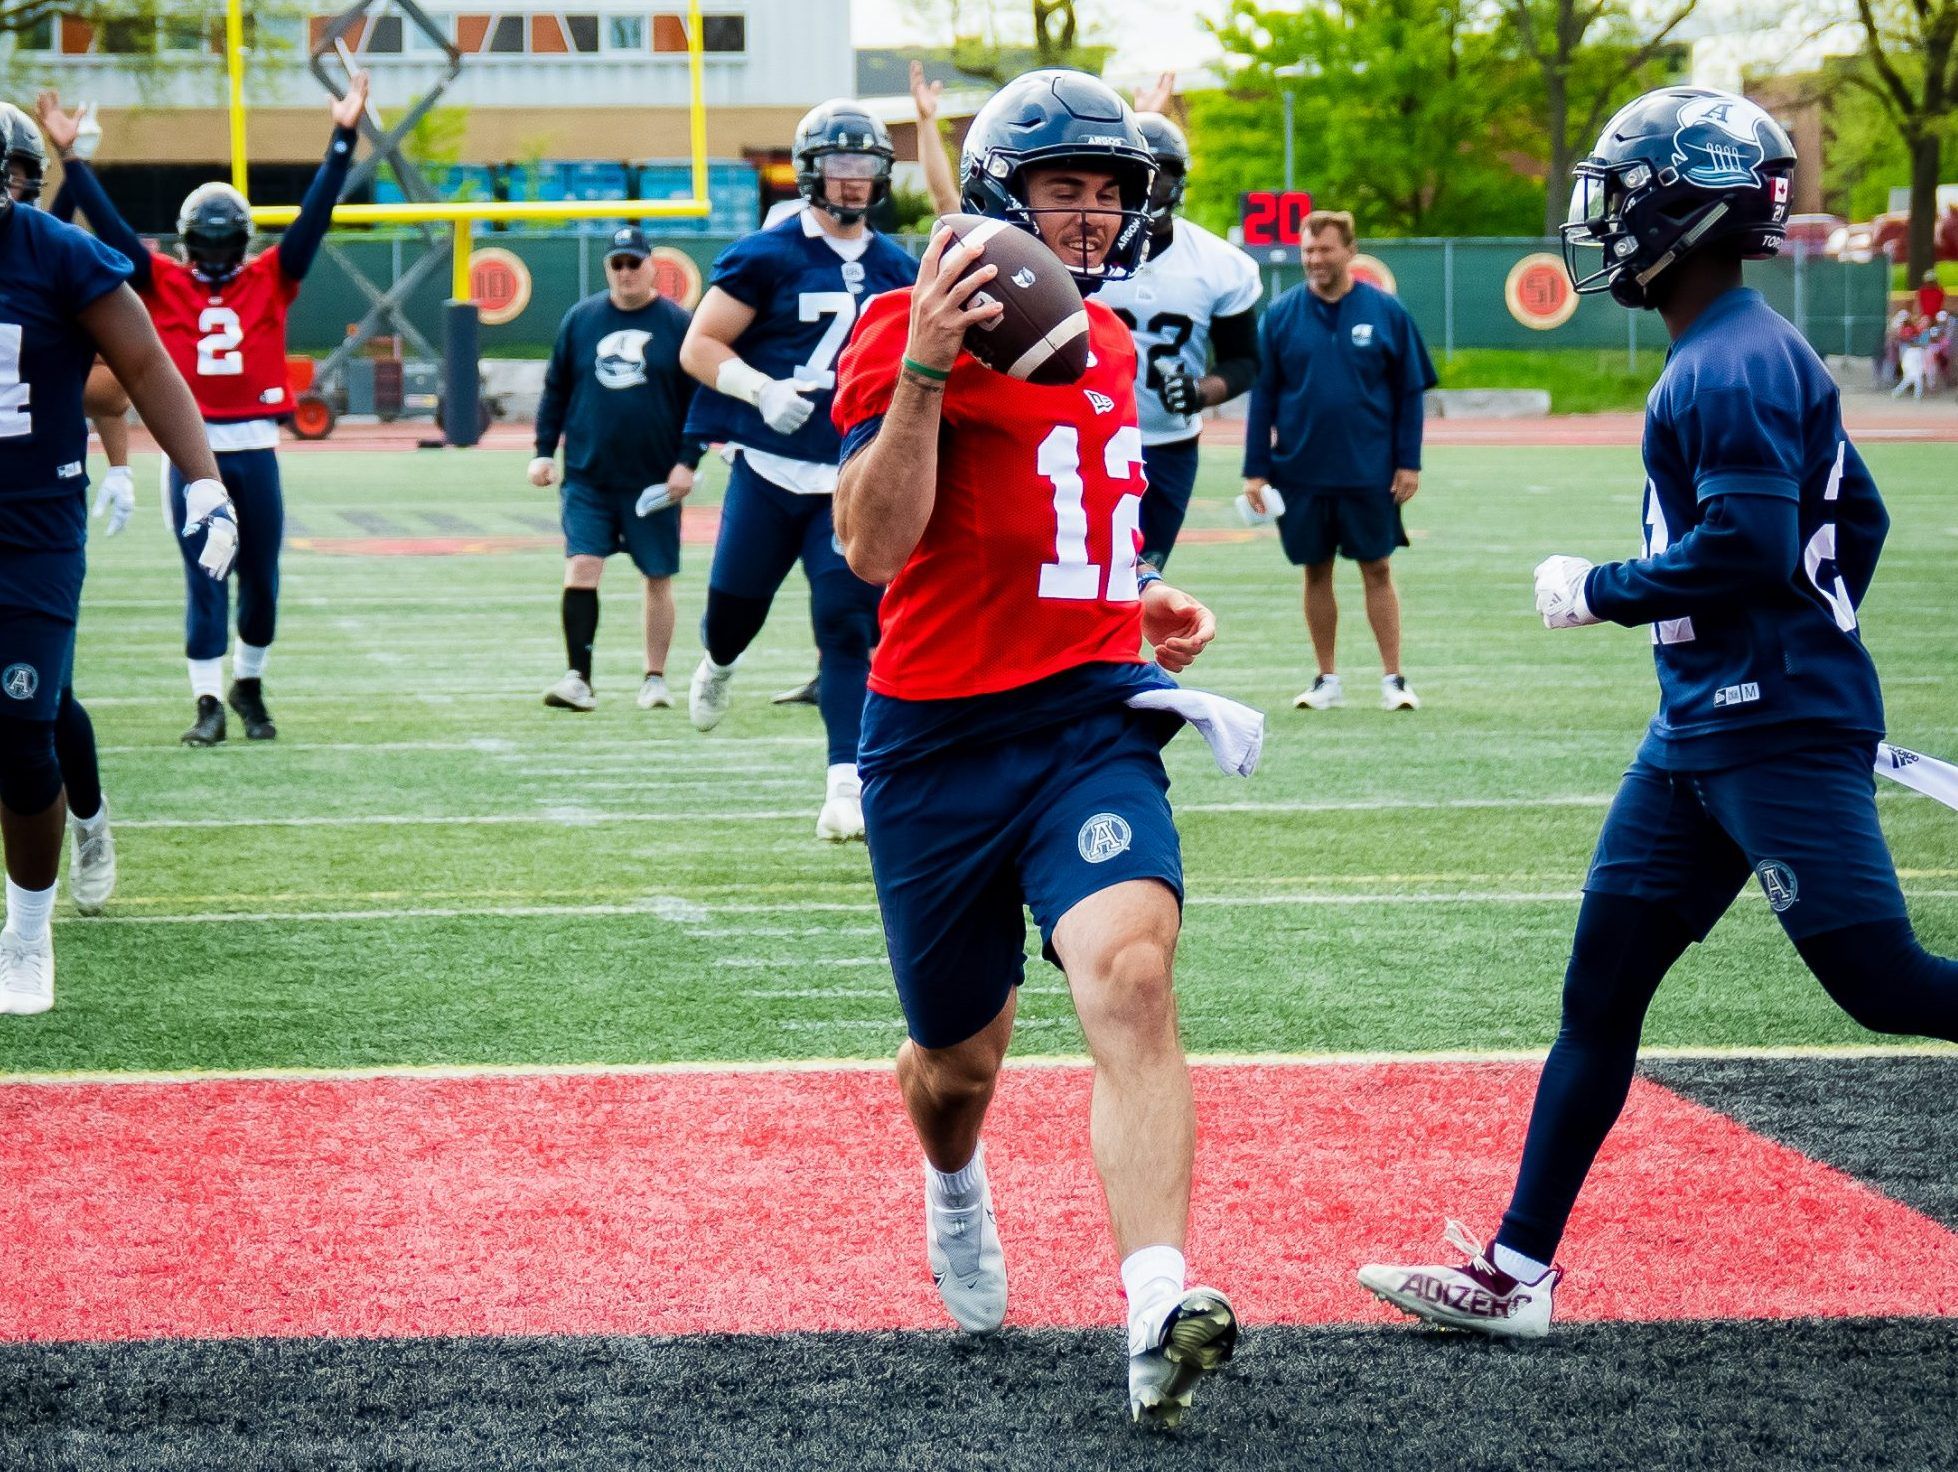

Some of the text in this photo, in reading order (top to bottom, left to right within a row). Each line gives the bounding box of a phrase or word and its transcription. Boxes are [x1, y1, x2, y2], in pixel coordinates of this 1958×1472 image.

[1701, 104, 1733, 123] A
[1088, 136, 1121, 146] ARGOS
[1244, 191, 1311, 246] 20
[197, 307, 244, 375] 2
[1037, 425, 1149, 601] 12
[1090, 820, 1121, 858] A
[1764, 868, 1790, 902] A
[1398, 1273, 1533, 1318] ADIZERO
